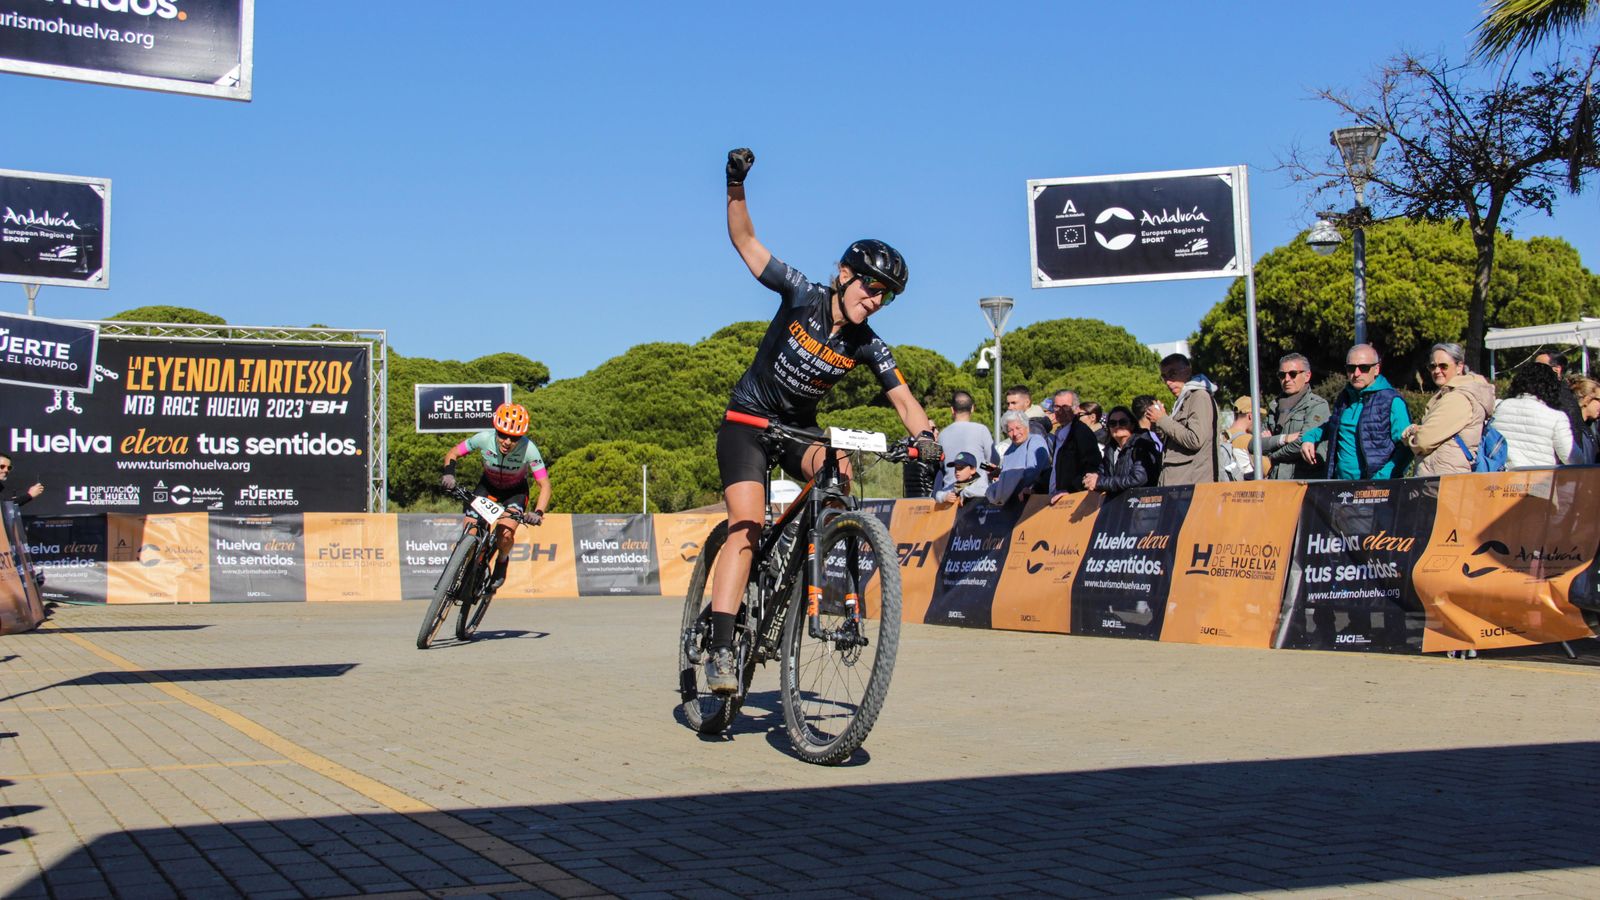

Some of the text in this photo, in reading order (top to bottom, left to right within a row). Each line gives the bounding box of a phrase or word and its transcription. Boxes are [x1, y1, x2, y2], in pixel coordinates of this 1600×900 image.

[2, 206, 82, 230] Andalucía
[1140, 205, 1210, 226] Andalucía
[2, 228, 38, 238] European
[40, 231, 65, 240] Region
[2, 236, 30, 244] SPORT
[1141, 230, 1172, 238] European
[8, 354, 21, 364] EL
[24, 356, 78, 371] ROMPIDO
[126, 356, 234, 392] LEYENDA
[240, 359, 352, 394] TARTESSOS
[124, 395, 154, 416] MTB
[162, 396, 200, 416] RACE
[207, 397, 258, 418] HUELVA
[266, 398, 304, 418] 2023
[310, 400, 348, 414] BH
[428, 412, 452, 420] HOTEL
[11, 428, 362, 456] Huelva eleva tus sentidos.
[117, 458, 250, 472] www.turismohuelva.org
[90, 484, 140, 493] DIPUTACIÓN
[216, 539, 295, 551] Huelva eleva
[406, 540, 447, 551] Huelva
[580, 538, 648, 550] Huelva eleva
[951, 536, 981, 552] Huelva
[1094, 530, 1170, 550] Huelva eleva
[1307, 530, 1415, 555] Huelva eleva
[510, 543, 558, 562] BH
[1216, 541, 1280, 558] DIPUTACIÓN
[216, 555, 237, 565] tus
[406, 555, 426, 565] tus
[581, 554, 599, 563] tus
[945, 558, 960, 572] tus
[1086, 557, 1105, 573] tus
[1106, 555, 1164, 575] sentidos.
[1212, 556, 1276, 570] DE HUELVA
[1210, 568, 1252, 579] OBJETIVOS
[1305, 558, 1402, 583] tus sentidos.
[1084, 580, 1151, 593] www.turismohuelva.org
[1308, 588, 1400, 600] www.turismohuelva.org
[1204, 627, 1218, 636] UCI
[1484, 628, 1505, 637] UCI
